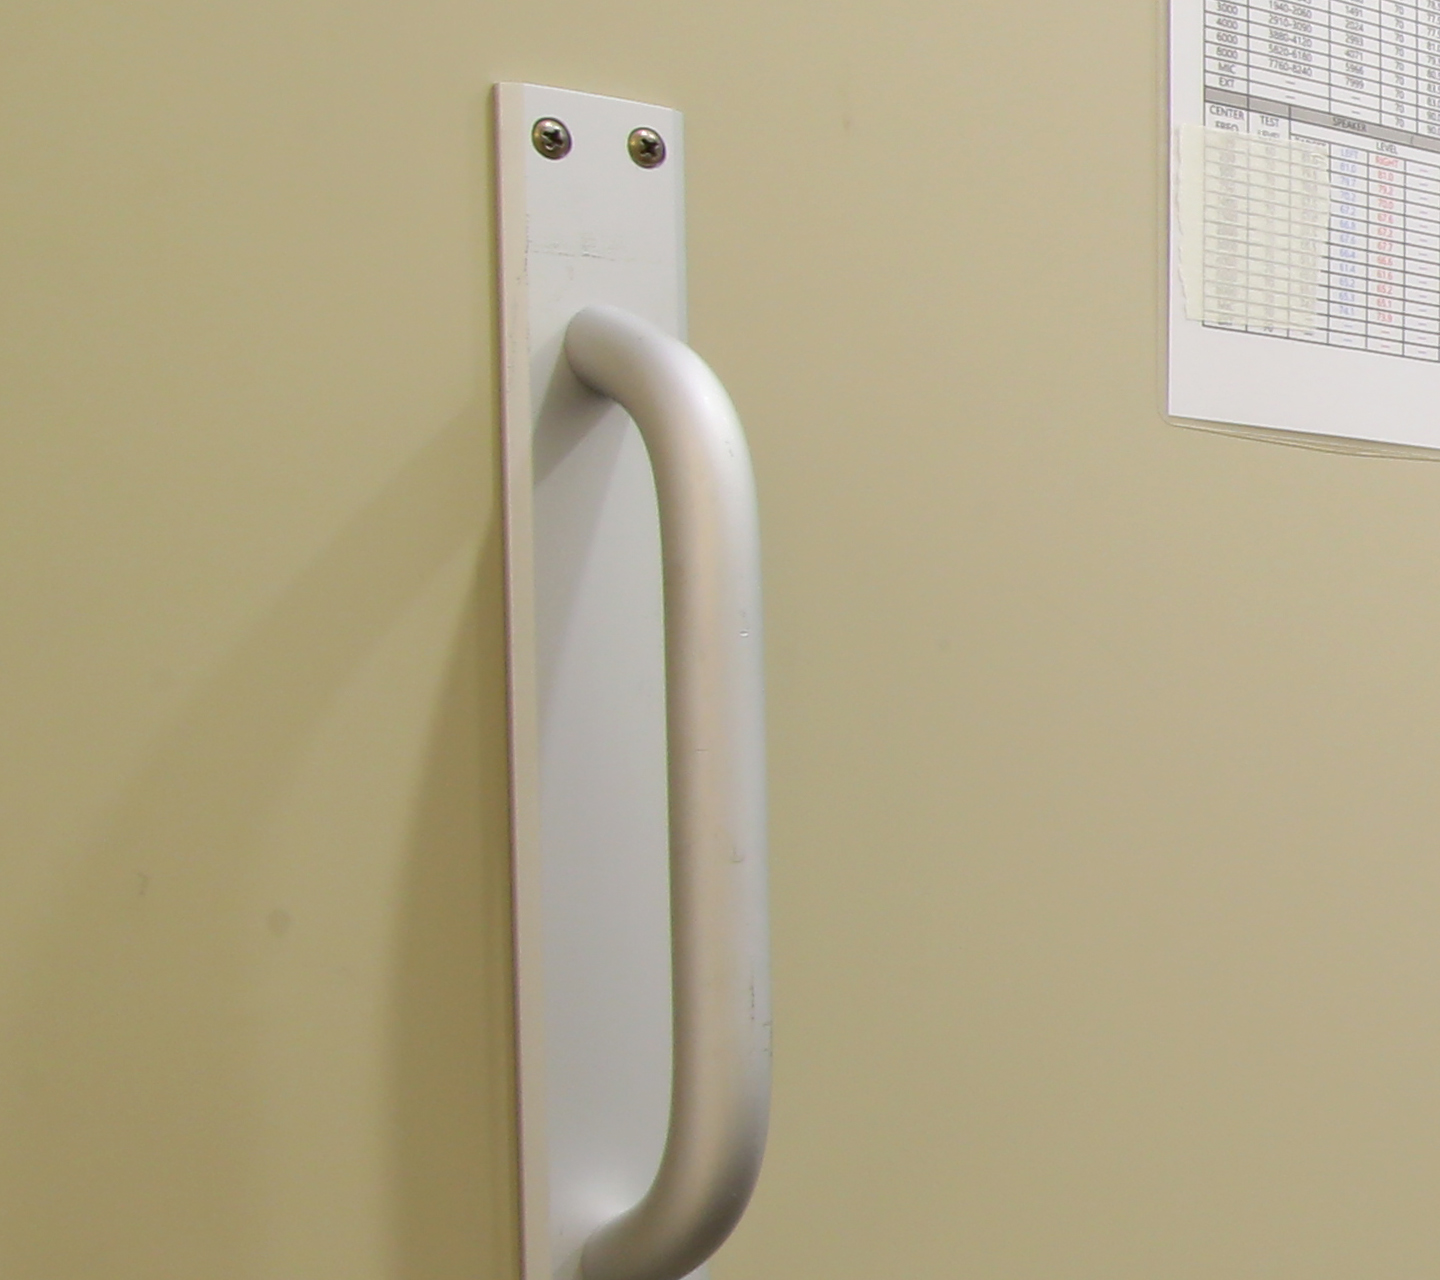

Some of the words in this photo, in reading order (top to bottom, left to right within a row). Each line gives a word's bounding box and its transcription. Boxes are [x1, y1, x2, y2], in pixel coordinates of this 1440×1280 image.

[1216, 2, 1238, 15] 3000
[1216, 17, 1238, 30] 4000
[1216, 32, 1238, 45] 6000
[1218, 62, 1236, 74] MIC
[1219, 77, 1235, 89] EXT
[1209, 104, 1245, 121] CENTER
[1260, 115, 1279, 128] TEST
[1333, 117, 1367, 133] SPEAKER
[1376, 141, 1398, 155] LEVEL
